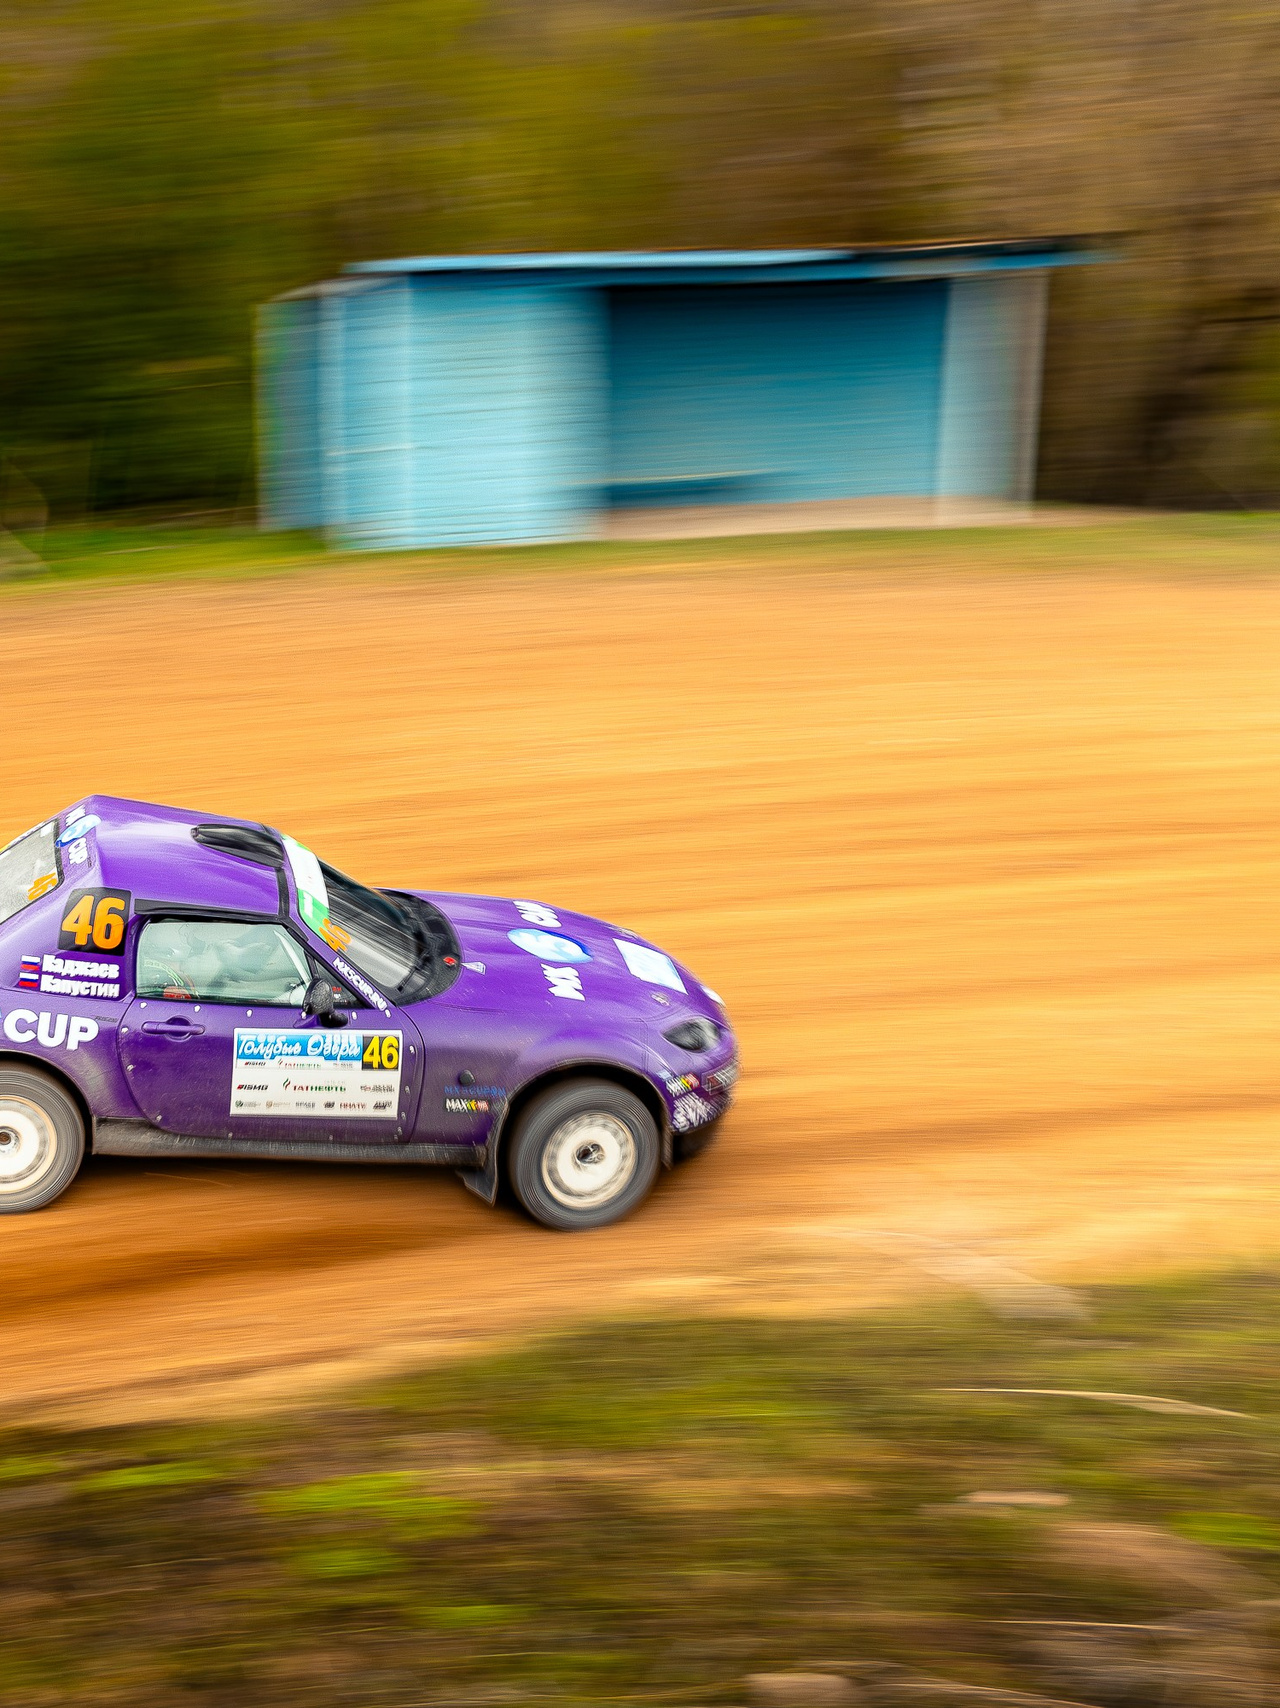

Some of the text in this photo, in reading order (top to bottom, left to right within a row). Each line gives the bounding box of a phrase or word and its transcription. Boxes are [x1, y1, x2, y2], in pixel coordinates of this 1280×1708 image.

[62, 895, 126, 949] 46
[318, 918, 352, 952] 46
[42, 954, 120, 979] Каджаев
[40, 974, 120, 998] Капустин
[3, 1009, 99, 1050] CUP
[238, 1034, 302, 1059] Голубые
[363, 1035, 399, 1069] 46
